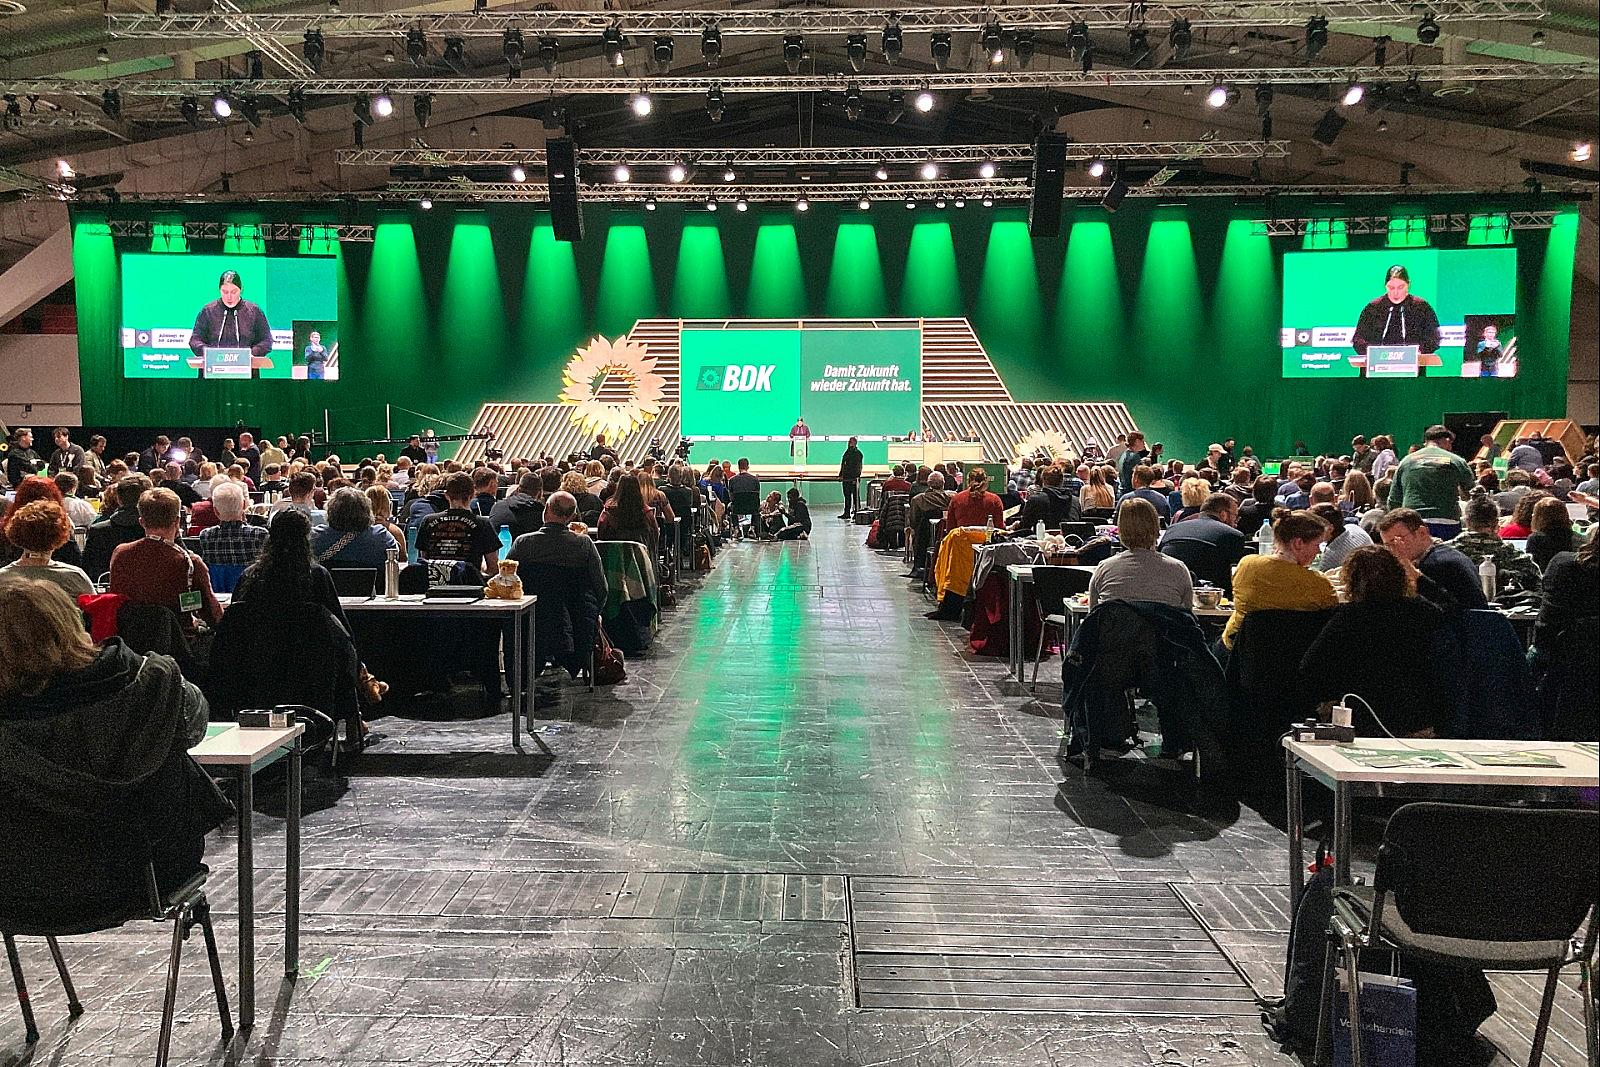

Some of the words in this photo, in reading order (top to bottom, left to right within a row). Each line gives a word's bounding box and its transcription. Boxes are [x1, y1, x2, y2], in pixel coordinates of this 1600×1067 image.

[224, 353, 240, 362] BDK
[1388, 351, 1405, 360] BDK
[824, 364, 857, 377] Damit
[857, 364, 899, 377] Zukunft
[722, 364, 777, 392] BDK
[810, 379, 848, 391] wieder
[848, 379, 891, 391] Zukunft
[891, 379, 912, 391] hat.
